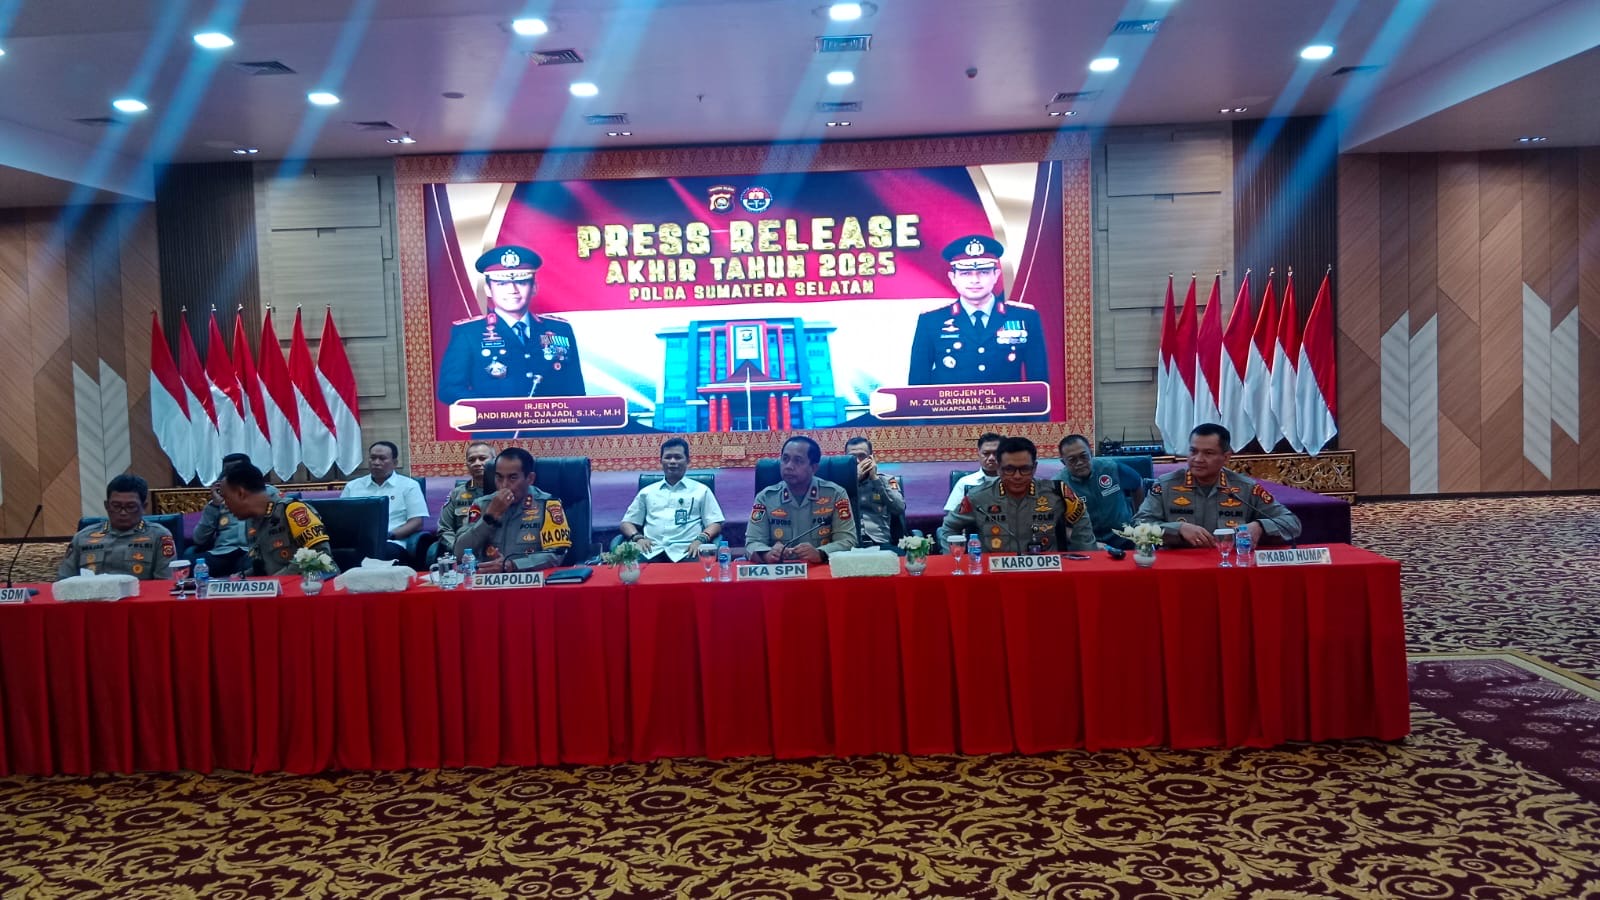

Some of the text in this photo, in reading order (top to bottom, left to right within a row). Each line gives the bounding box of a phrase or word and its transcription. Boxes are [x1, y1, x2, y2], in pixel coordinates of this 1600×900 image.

[577, 214, 921, 258] PRESS RELEASE
[606, 251, 896, 284] AKHIR TAHUN 2025
[629, 279, 874, 301] POLDA SUMATERA SELATAN
[938, 388, 997, 398] BRIGJEN POL
[524, 402, 550, 410] IRJEN
[922, 397, 983, 407] ZULKARNAIN,
[932, 403, 1007, 412] WAKAPOLDA SUMSEL
[477, 412, 500, 420] ANDI
[500, 411, 522, 419] RIAN
[534, 410, 575, 419] DJAJADI,
[603, 408, 622, 417] M.H
[551, 417, 580, 425] SUMSEL
[1218, 510, 1244, 518] POLRI
[541, 530, 554, 545] KA
[1001, 555, 1060, 568] KARO OPS
[1266, 550, 1295, 562] KABID
[748, 564, 805, 576] KA SPN
[484, 573, 541, 585] KAPOLDA
[219, 582, 275, 593] IRWASDA
[1, 589, 24, 600] SDM
